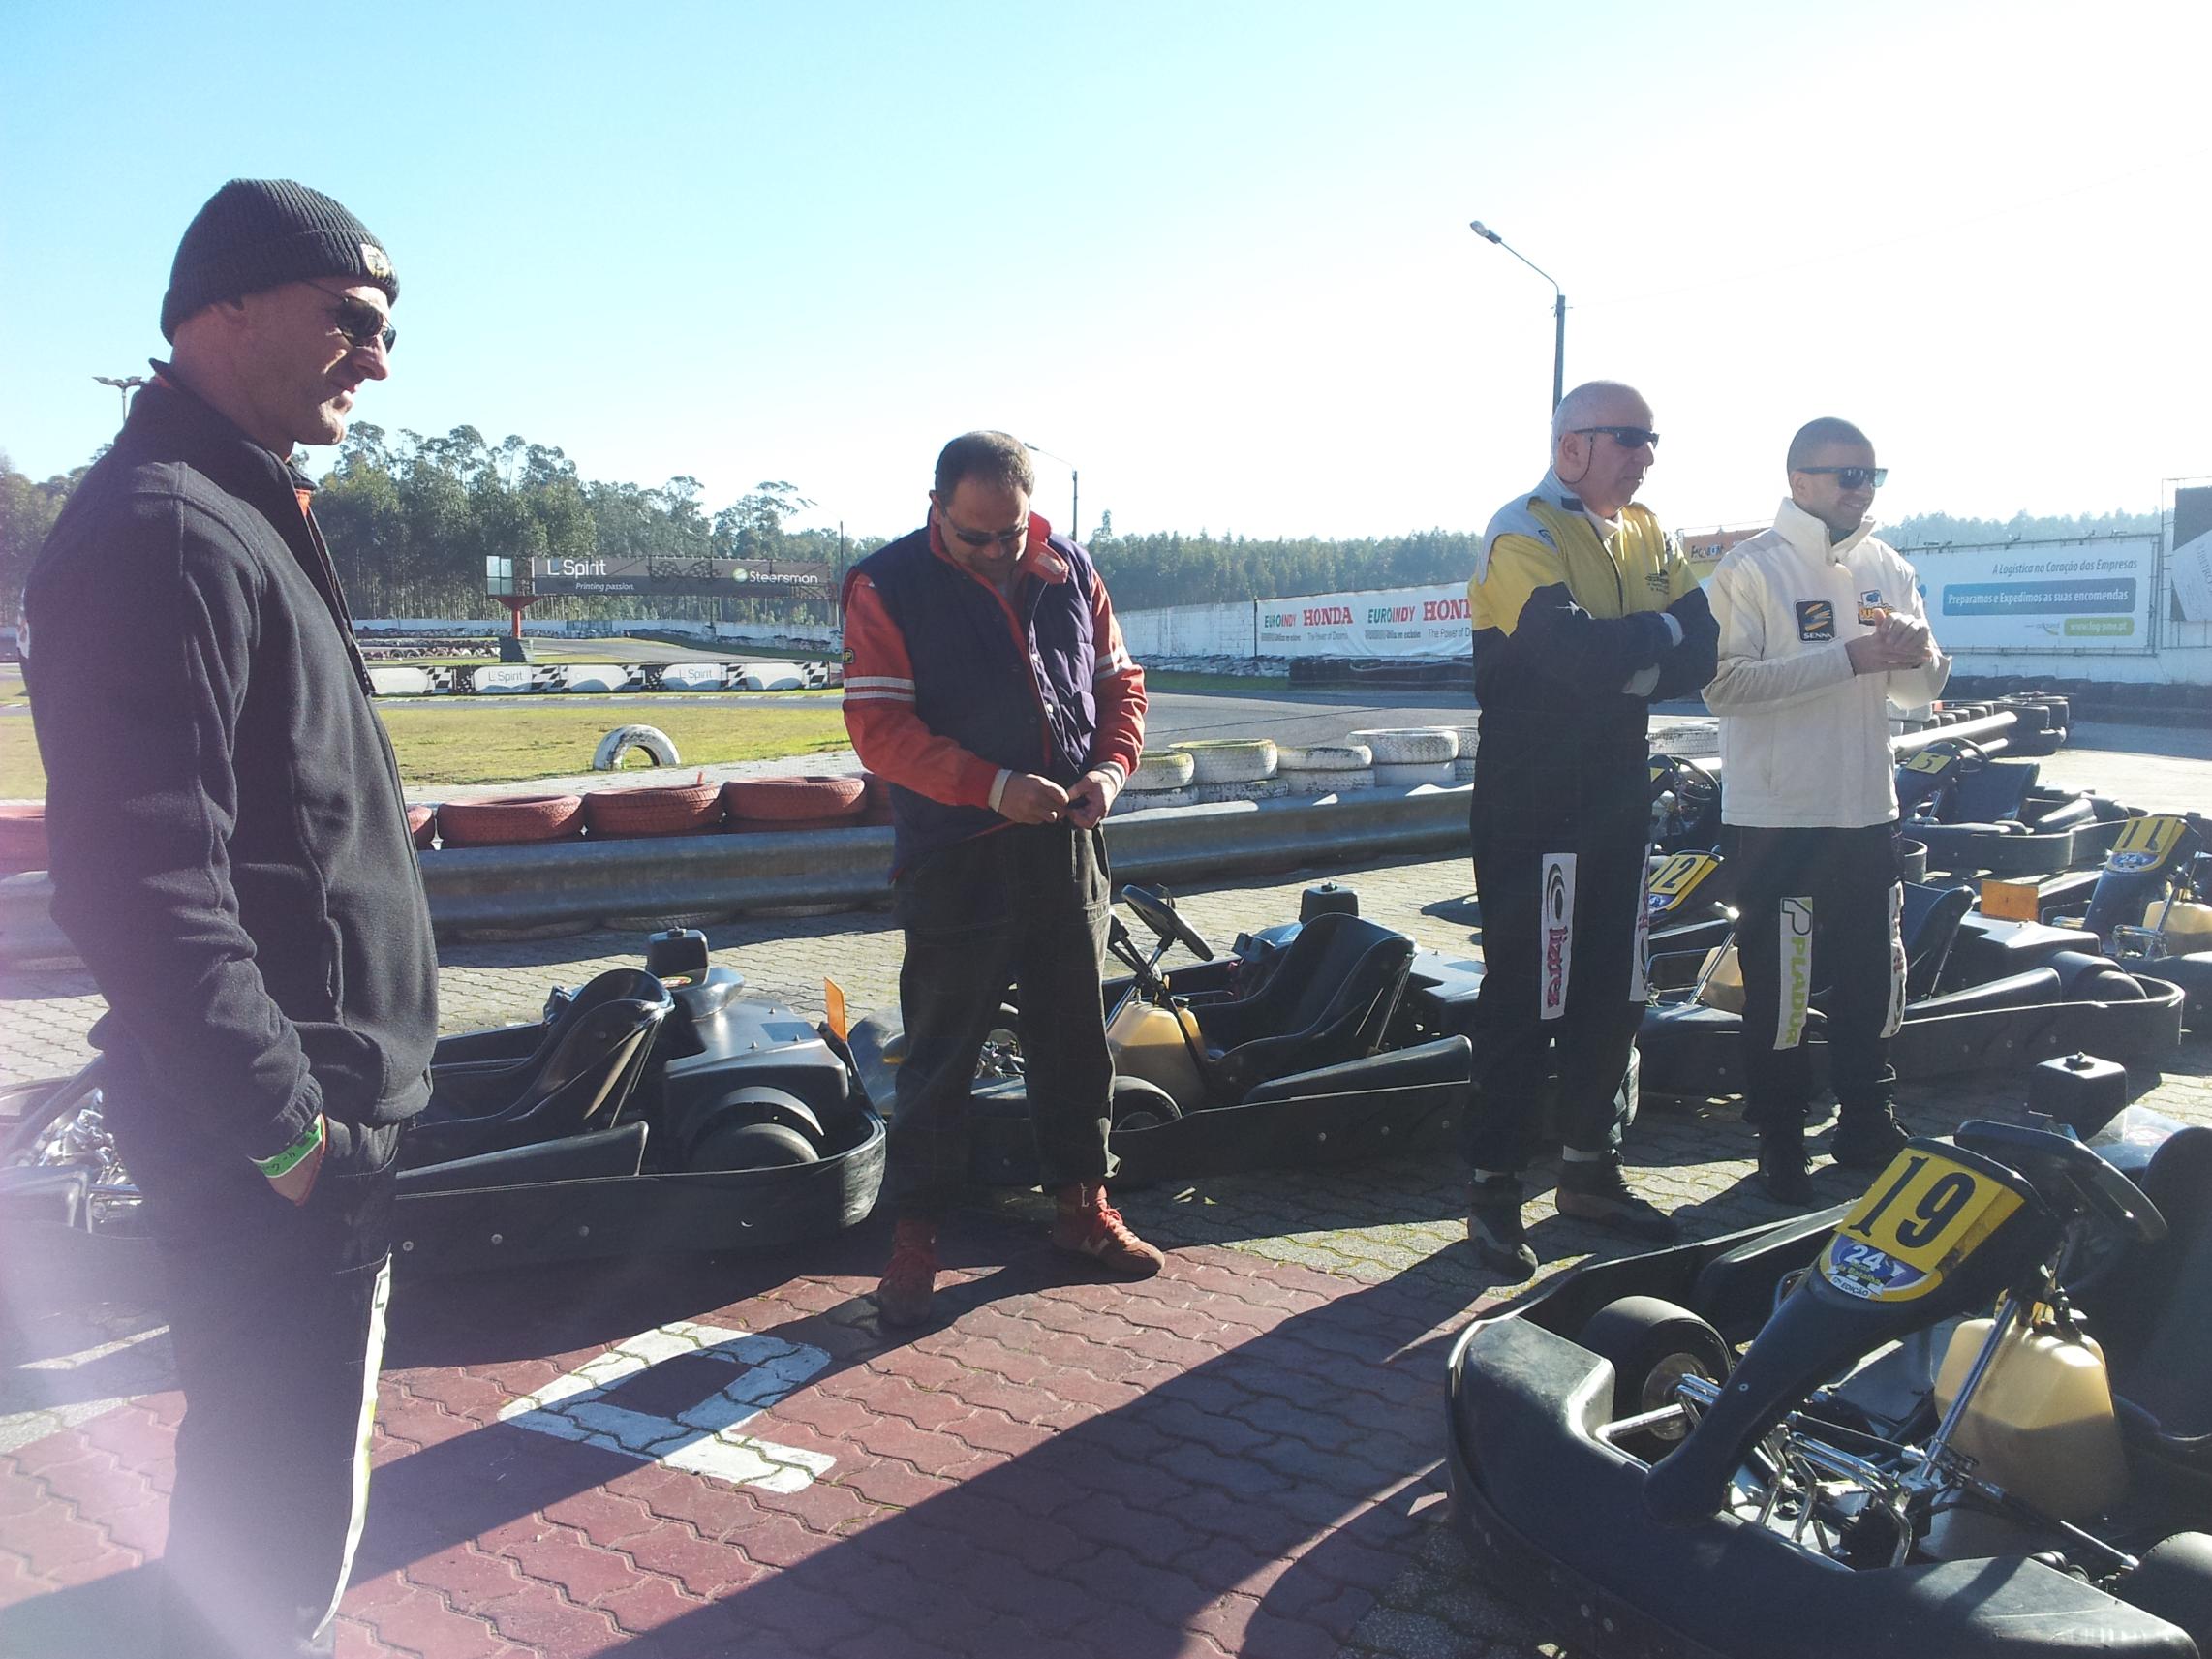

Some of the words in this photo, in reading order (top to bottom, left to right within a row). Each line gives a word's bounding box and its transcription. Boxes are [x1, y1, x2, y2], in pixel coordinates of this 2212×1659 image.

[546, 559, 560, 575] L
[563, 559, 607, 579] Spirit
[750, 570, 819, 584] Steersman
[575, 583, 604, 592] Printing
[2000, 592, 2042, 605] Expedimos
[2043, 594, 2052, 602] as
[2054, 593, 2073, 602] suas
[2074, 589, 2129, 601] encomendas
[1264, 614, 1296, 628] EUROINDY
[1303, 606, 1353, 626] HONDA
[1367, 606, 1415, 624] EUROINDY
[1429, 628, 1439, 638] The
[498, 671, 523, 683] Spirit
[689, 668, 712, 680] Spirit
[1918, 755, 1940, 769] 5
[1649, 858, 1697, 888] 12
[1786, 936, 1806, 1044] PLADUR
[1848, 1156, 1976, 1249] 19
[1844, 1244, 1886, 1271] 24
[1841, 1282, 1869, 1297] EDIÇÃO
